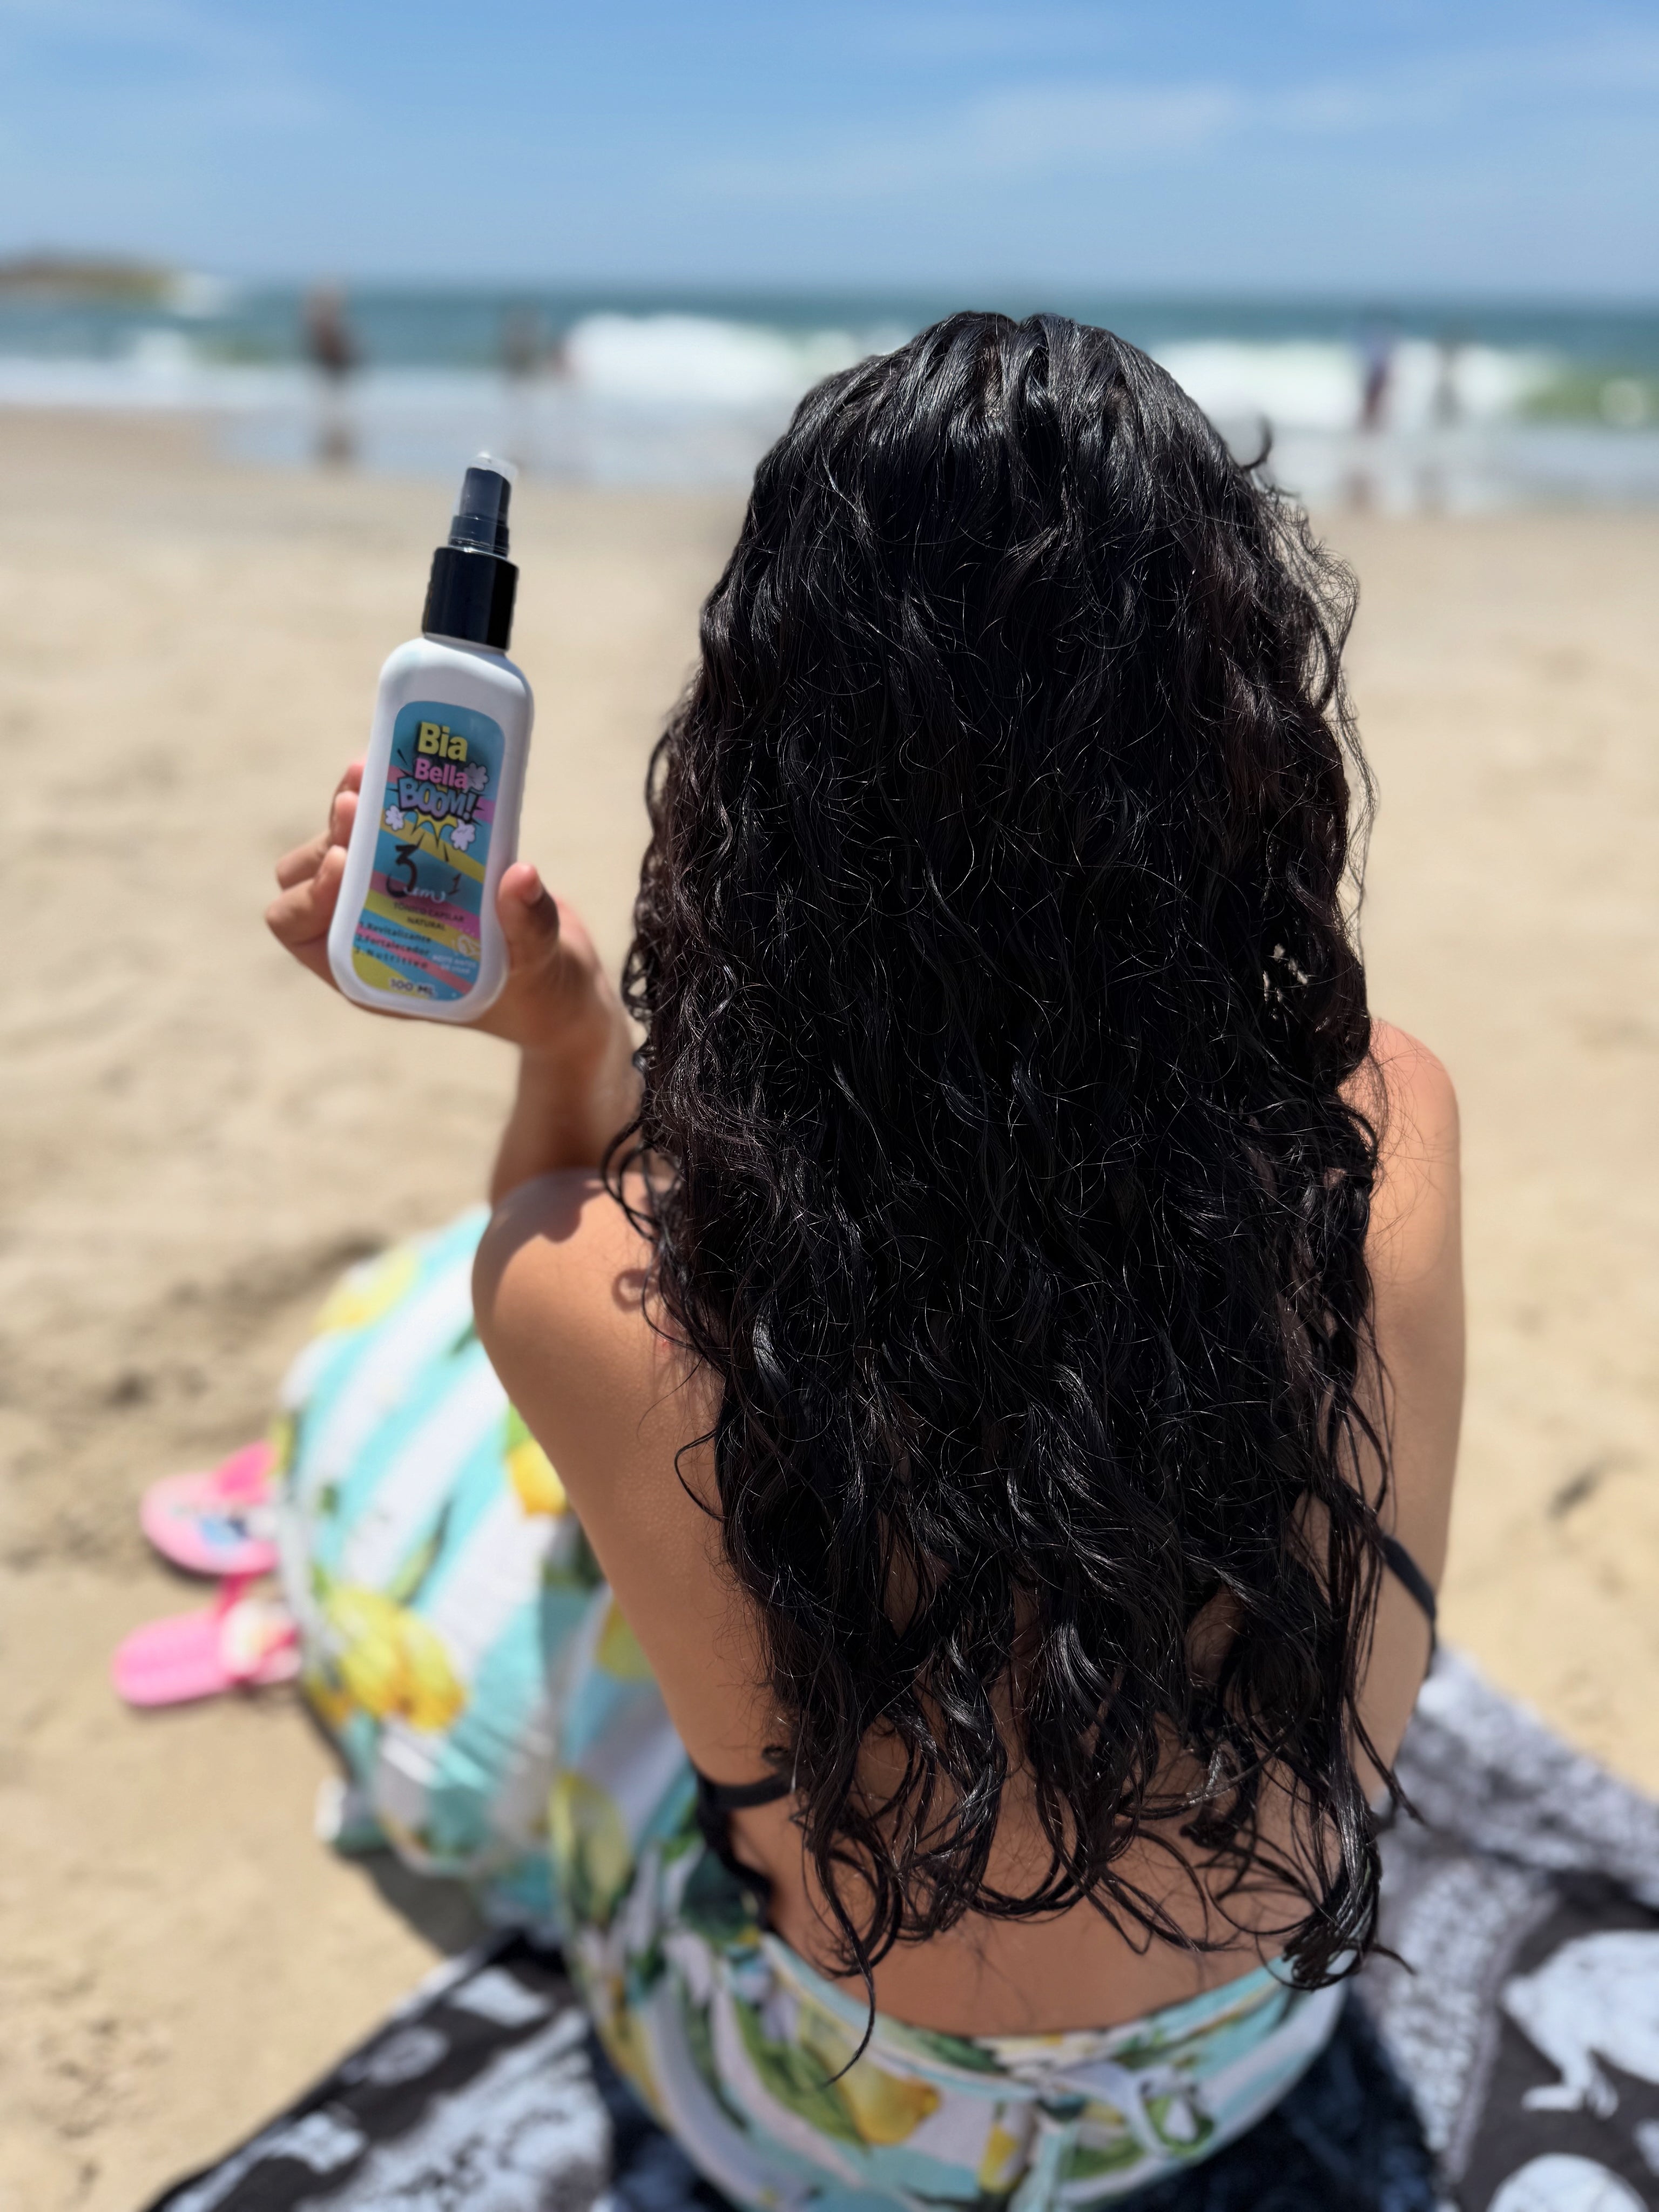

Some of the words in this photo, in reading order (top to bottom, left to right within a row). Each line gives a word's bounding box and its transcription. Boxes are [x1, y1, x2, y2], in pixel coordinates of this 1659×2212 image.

[417, 721, 468, 762] Bia
[414, 758, 468, 789] Bella
[397, 777, 478, 824] BOOM!
[386, 844, 419, 898] 3
[407, 916, 446, 931] NATURAL
[390, 977, 414, 991] 100
